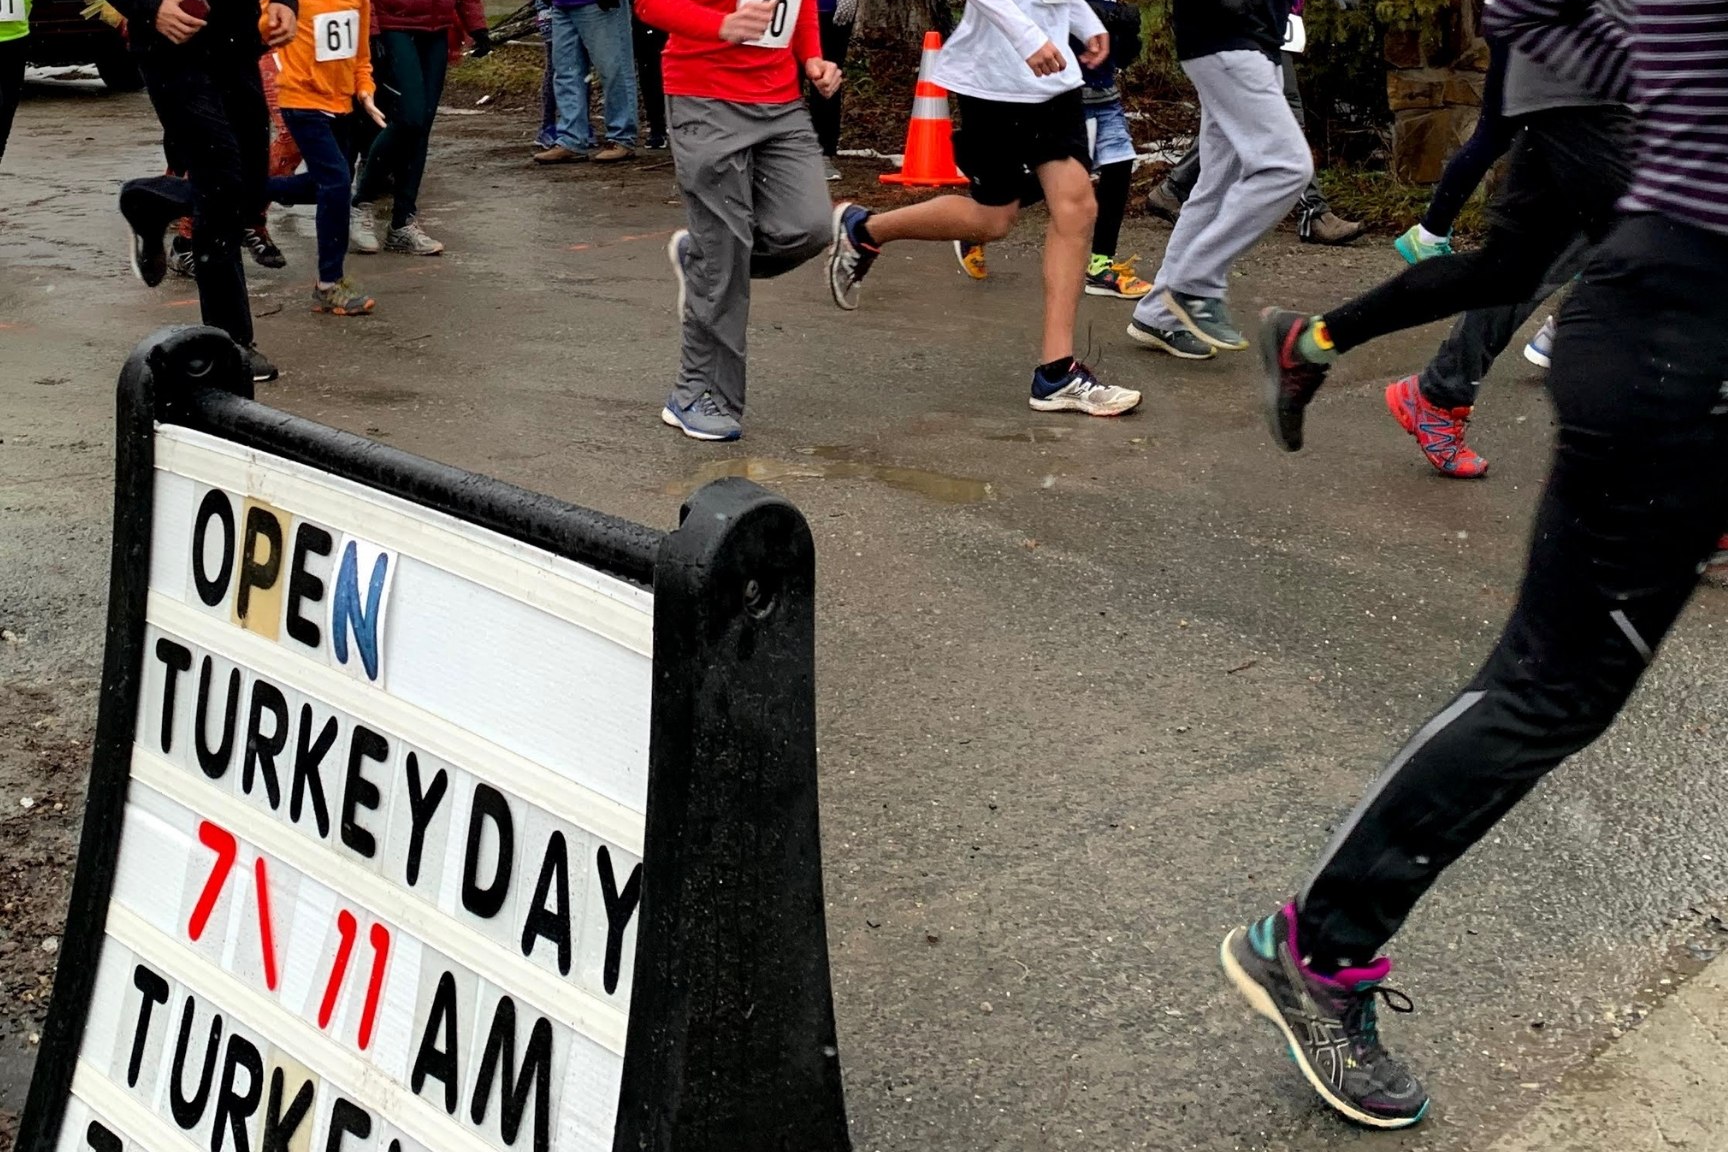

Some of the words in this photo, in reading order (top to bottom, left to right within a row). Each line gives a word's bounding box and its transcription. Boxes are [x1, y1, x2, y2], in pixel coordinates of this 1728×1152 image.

[327, 18, 352, 52] 61
[193, 489, 389, 683] OPEN
[411, 971, 553, 1152] AM
